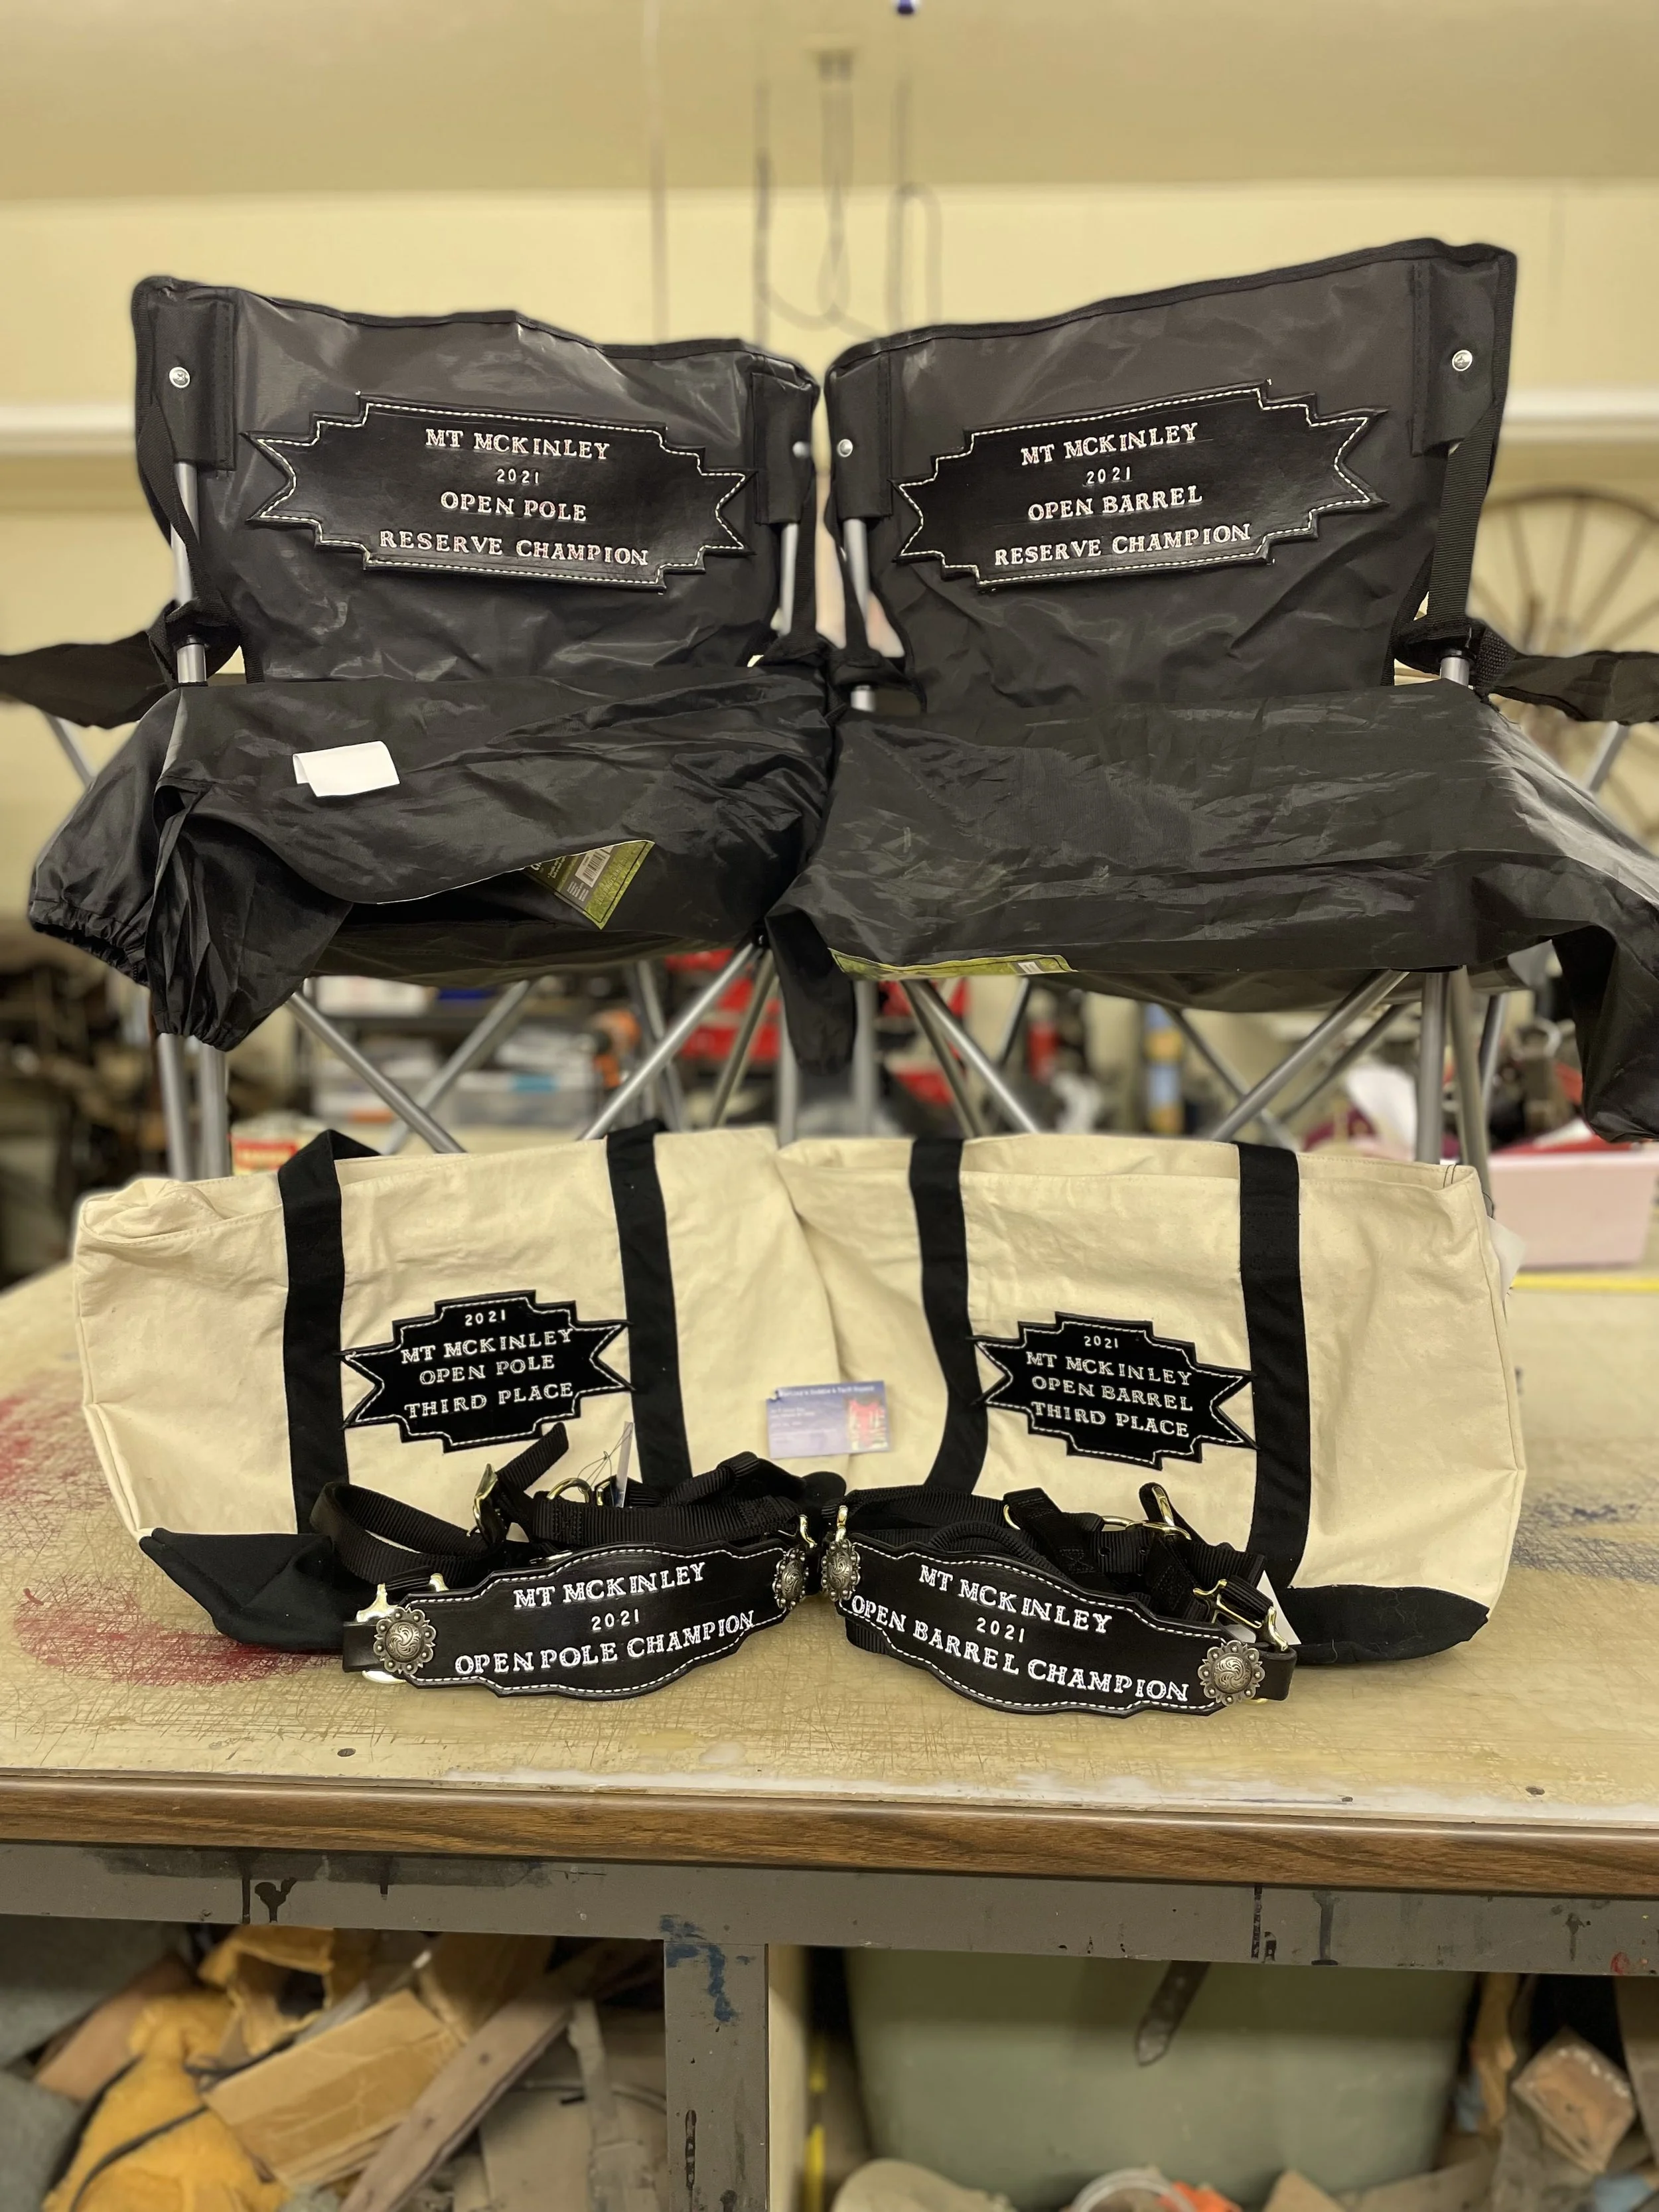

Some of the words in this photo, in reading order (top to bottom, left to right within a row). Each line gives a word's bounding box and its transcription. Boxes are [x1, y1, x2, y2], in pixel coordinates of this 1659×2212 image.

[426, 429, 463, 447] MT
[474, 433, 609, 459] MCKINLEY
[1021, 444, 1054, 465] MT
[1064, 423, 1197, 459] MCKINLEY
[497, 469, 538, 484] 2021
[1087, 467, 1129, 484] 2021
[441, 492, 514, 514] OPEN
[524, 500, 586, 522] POLE
[1029, 498, 1093, 520] OPEN
[1102, 486, 1202, 514] BARREL
[380, 531, 502, 555] RESERVE
[516, 540, 648, 565] CHAMPION
[995, 540, 1101, 565] RESERVE
[1113, 524, 1250, 555] CHAMPION
[465, 1309, 505, 1326] 2021
[401, 1345, 435, 1364] MT
[444, 1329, 573, 1358] MCKINLEY
[1084, 1336, 1118, 1349] 2021
[419, 1365, 486, 1384] OPEN
[496, 1355, 554, 1375] POLE
[1026, 1352, 1057, 1367] MT
[1066, 1357, 1192, 1385] MCKINLEY
[404, 1394, 486, 1418] THIRD
[498, 1382, 573, 1404] PLACE
[1032, 1376, 1095, 1396] OPEN
[1102, 1386, 1192, 1411] BARREL
[1031, 1402, 1106, 1425] THIRD
[1116, 1413, 1189, 1438] PLACE
[514, 1586, 555, 1608] MT
[563, 1562, 705, 1603] MCKINLEY
[919, 1565, 953, 1591] MT
[959, 1579, 1112, 1633] MCKINLEY
[591, 1609, 638, 1631] 2021
[977, 1617, 1024, 1643] 2021
[455, 1652, 534, 1674] OPEN
[540, 1643, 617, 1668] POLE
[627, 1611, 755, 1657] CHAMPION
[852, 1595, 906, 1632] OPEN
[913, 1620, 1019, 1674] BARREL
[1028, 1660, 1189, 1702] CHAMPION
